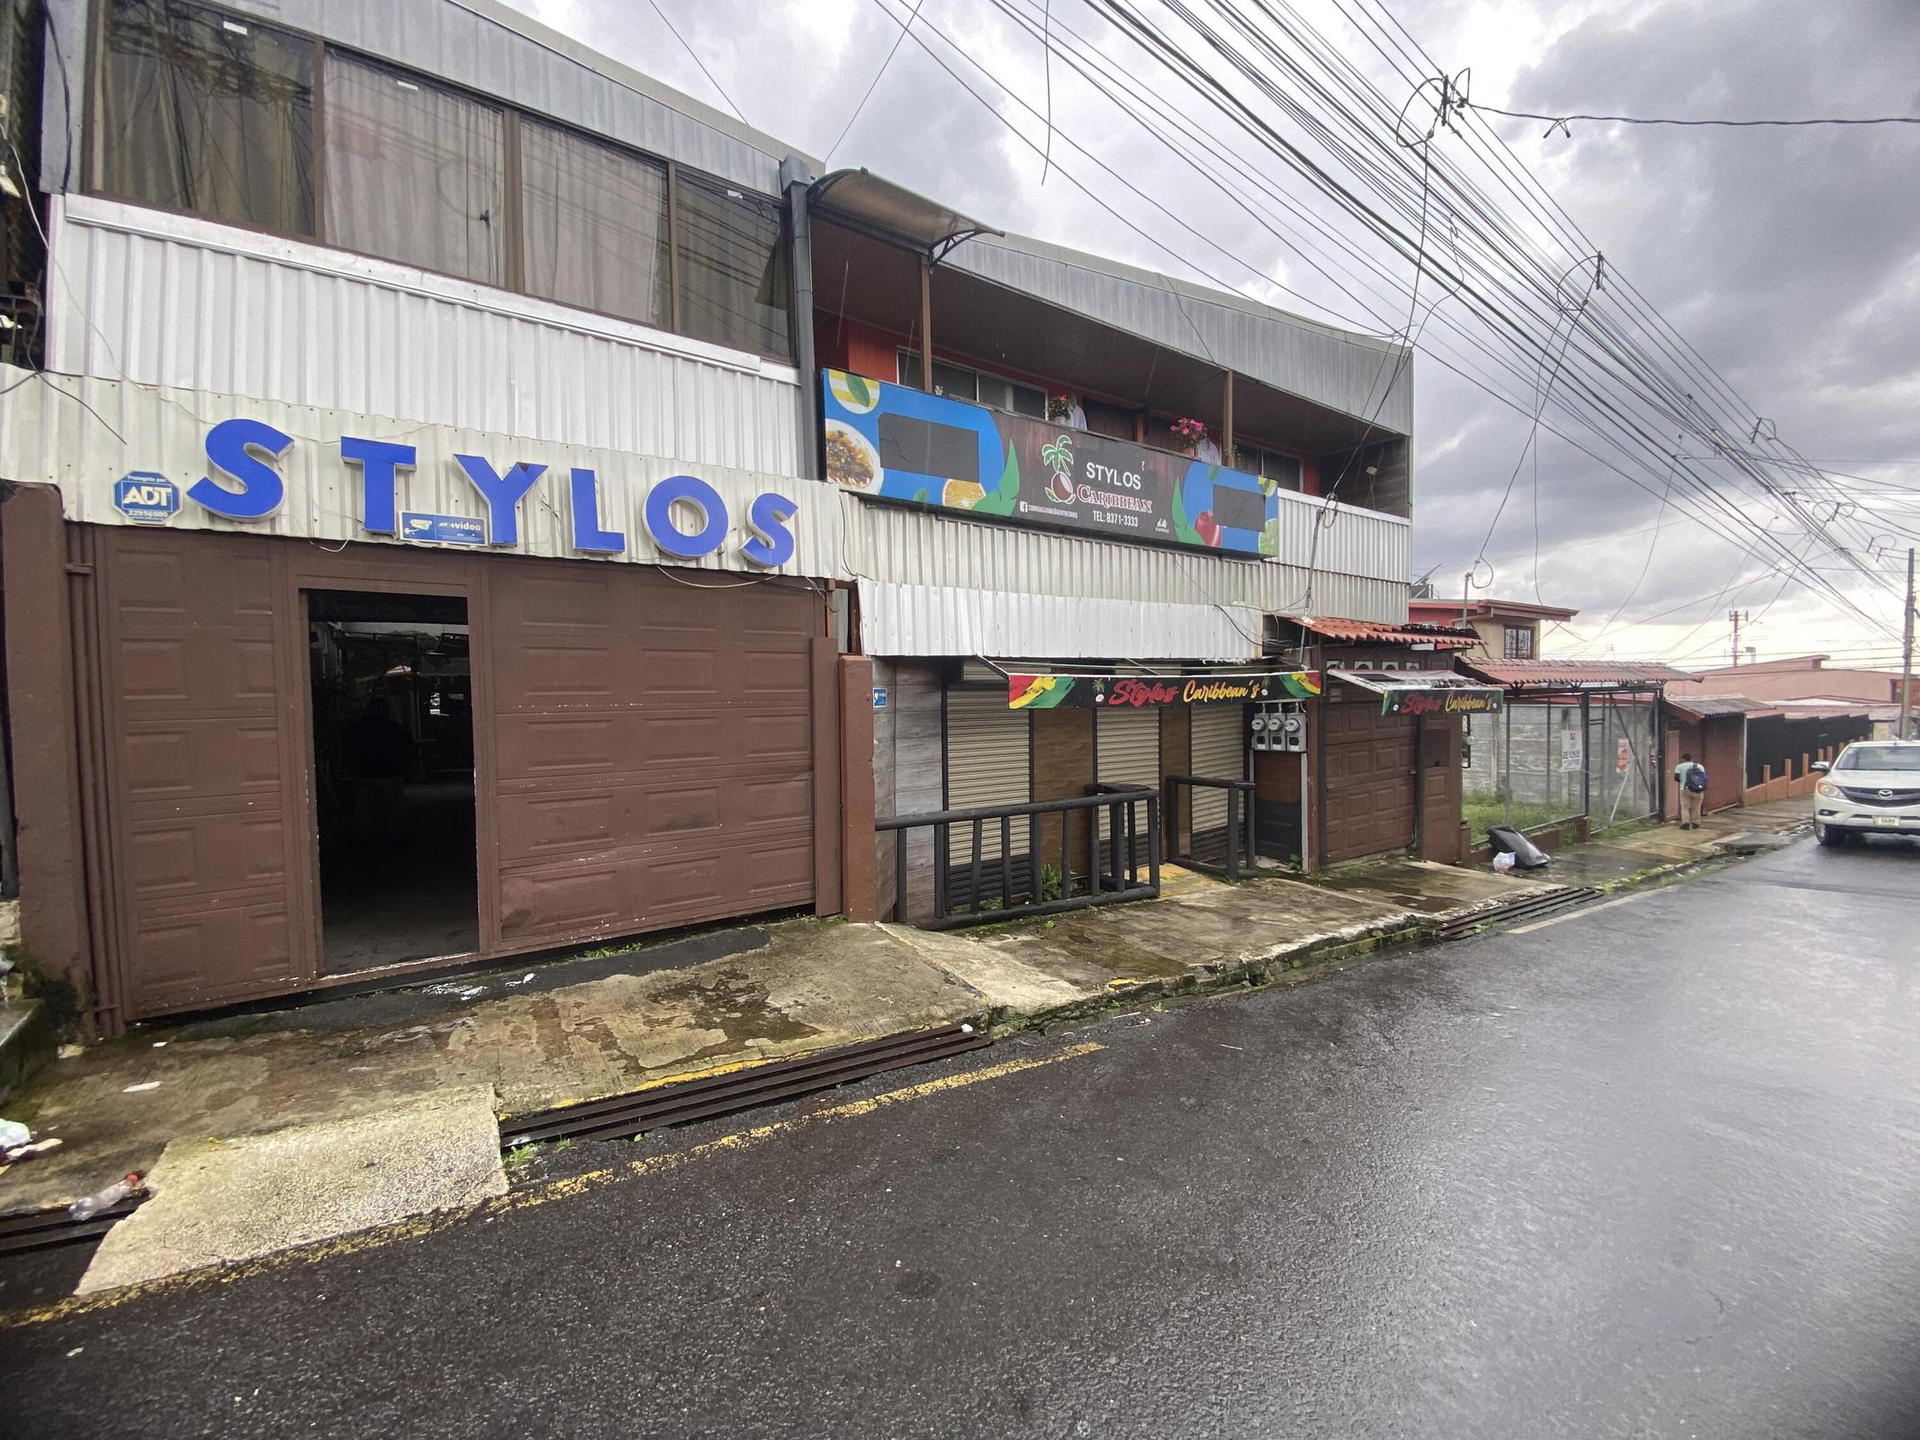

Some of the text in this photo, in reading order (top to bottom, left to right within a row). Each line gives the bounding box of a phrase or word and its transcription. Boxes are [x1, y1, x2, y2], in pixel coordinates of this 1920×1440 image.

[1085, 461, 1142, 490] STYLOS
[123, 486, 172, 506] ADT
[187, 418, 799, 568] STYLOS
[1076, 483, 1153, 514] CARIBBEAN
[1092, 510, 1106, 523] TEL:
[1106, 511, 1139, 528] 8371-3333
[1182, 679, 1261, 703] Caribbean's
[1445, 691, 1493, 713] Caribbean's
